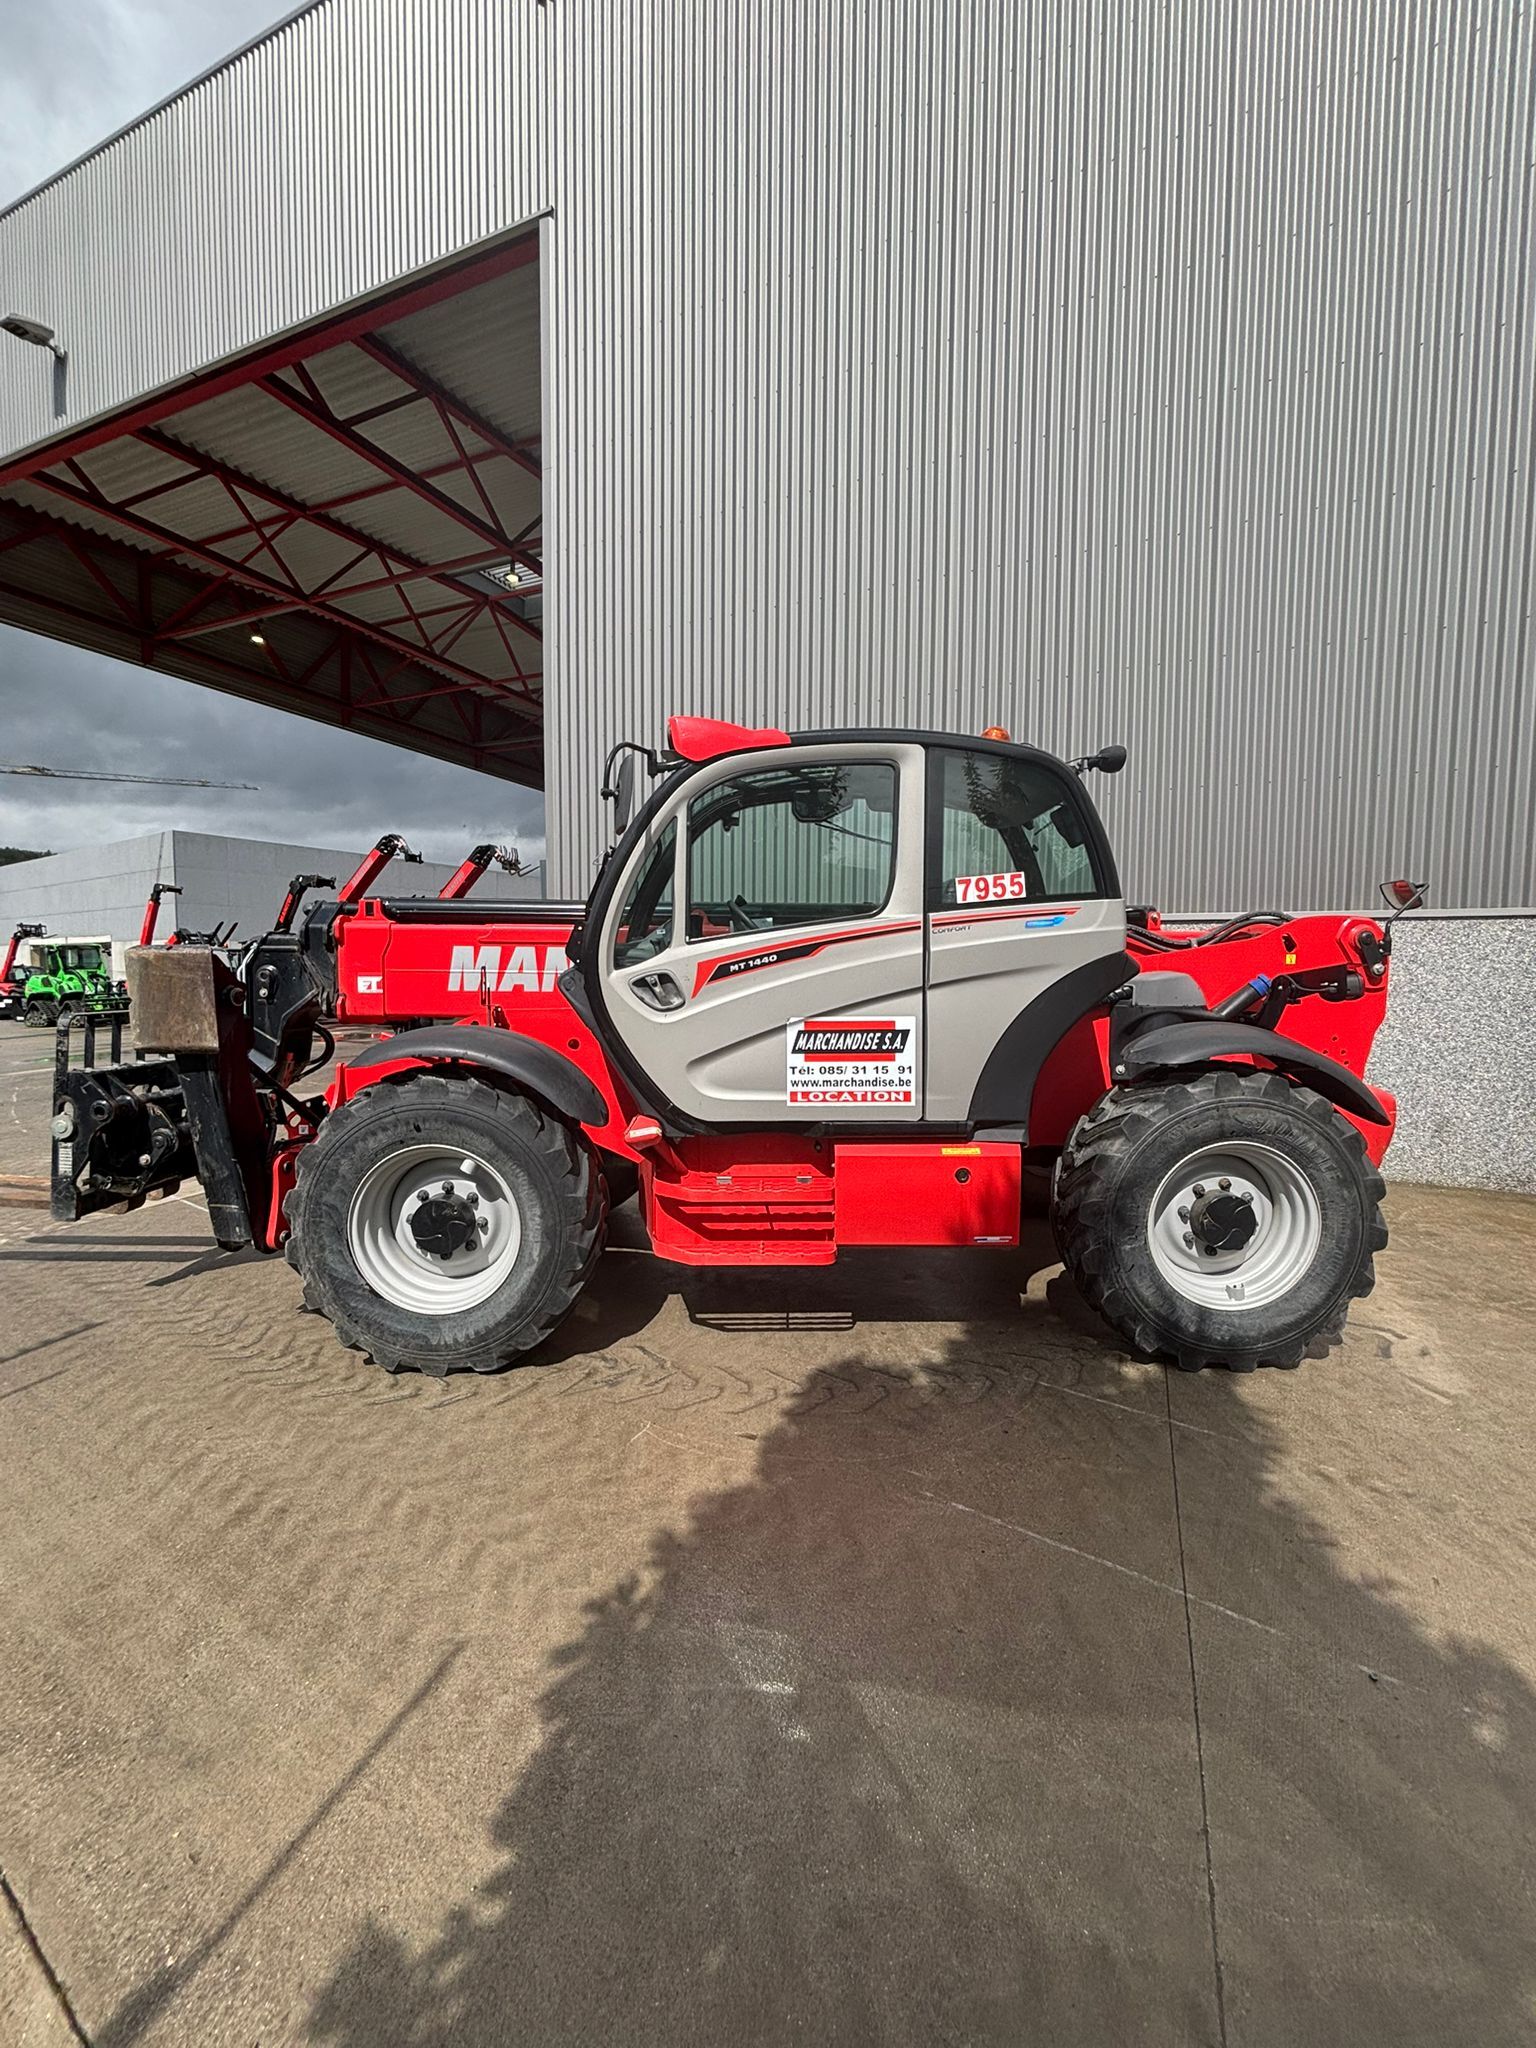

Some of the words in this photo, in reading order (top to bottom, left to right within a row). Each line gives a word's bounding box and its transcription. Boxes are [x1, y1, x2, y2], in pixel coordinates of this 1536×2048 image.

[957, 873, 1024, 902] 7955
[729, 963, 747, 973] MT
[747, 954, 778, 968] 1440
[795, 1032, 882, 1051] MARCHANDISE
[881, 1032, 905, 1051] S.A.
[789, 1065, 815, 1075] Tél:
[818, 1065, 848, 1075] 085/
[851, 1065, 867, 1075] 31
[872, 1065, 889, 1075] 15
[897, 1065, 913, 1075] 91
[790, 1076, 912, 1088] www.marchandise.be
[796, 1091, 905, 1102] LOCATION
